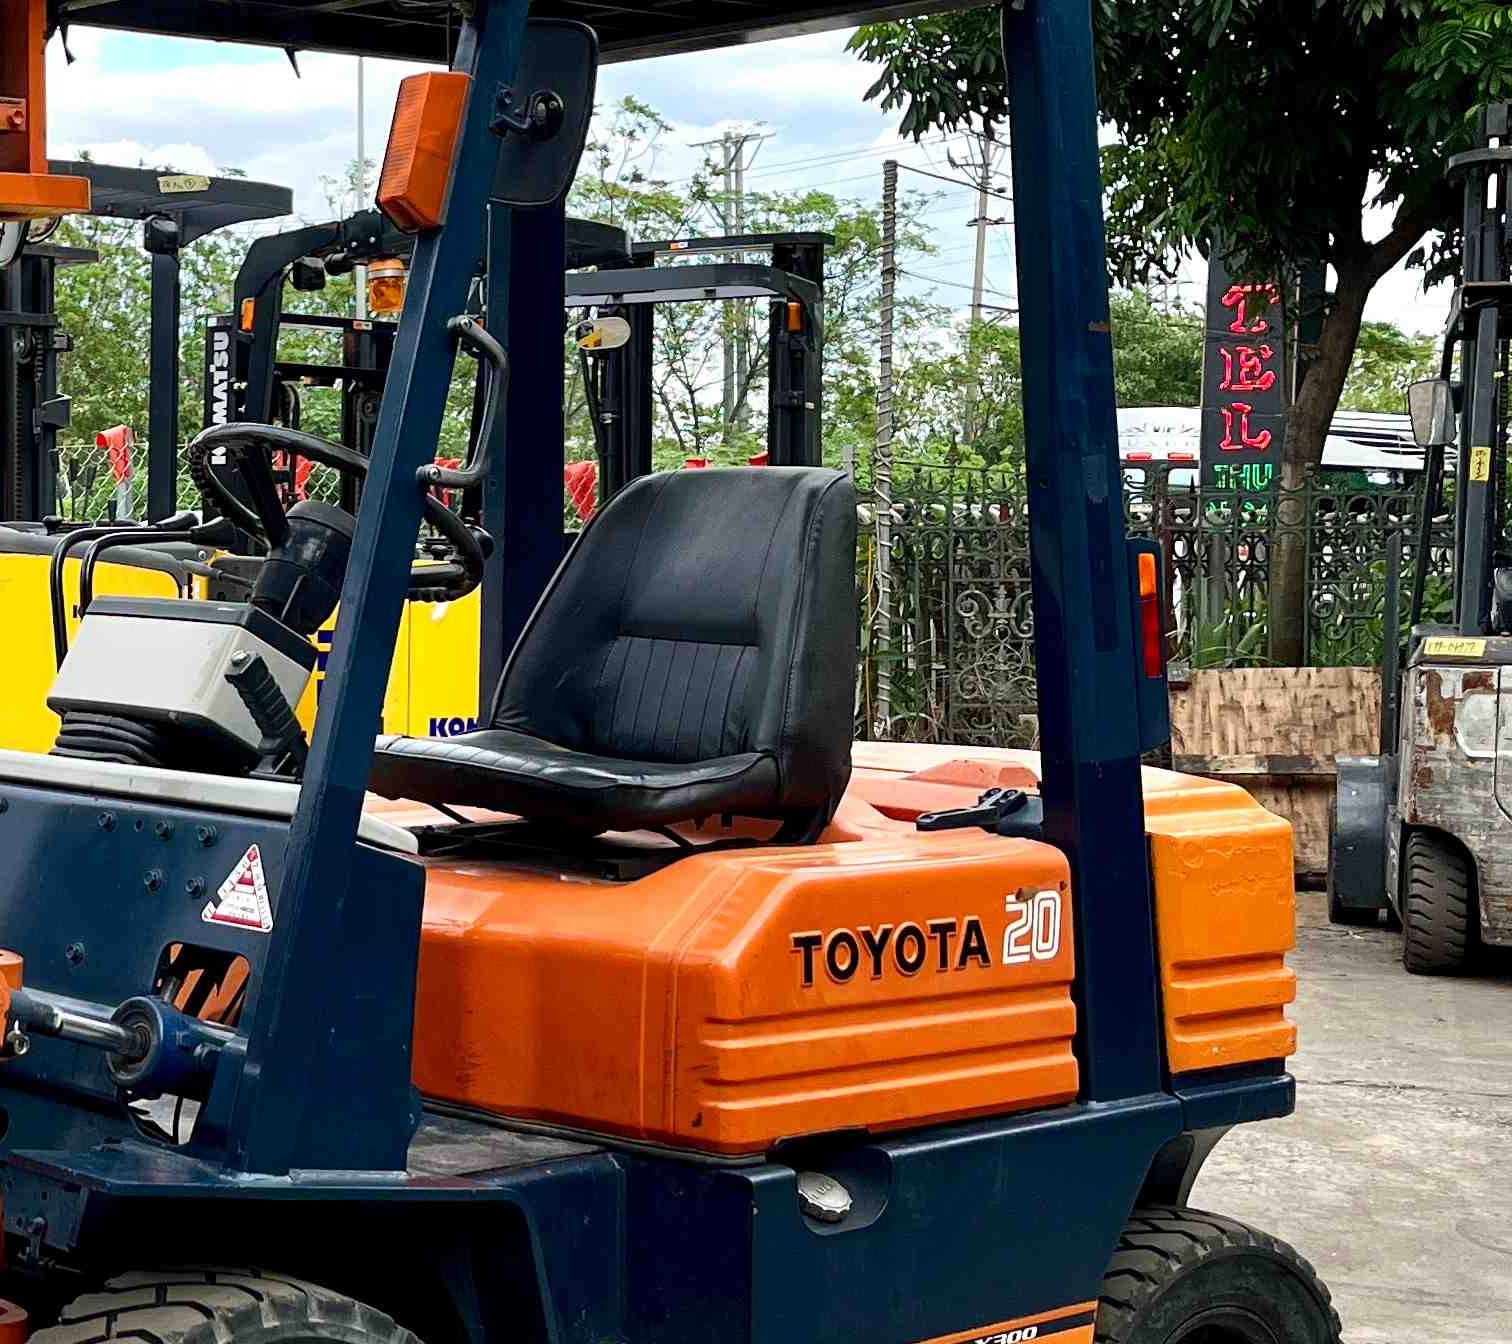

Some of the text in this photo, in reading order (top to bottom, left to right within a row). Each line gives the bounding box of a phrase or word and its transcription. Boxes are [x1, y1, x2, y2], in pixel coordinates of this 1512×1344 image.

[210, 331, 230, 465] KMATSU
[790, 889, 1061, 987] TOYOTA 20
